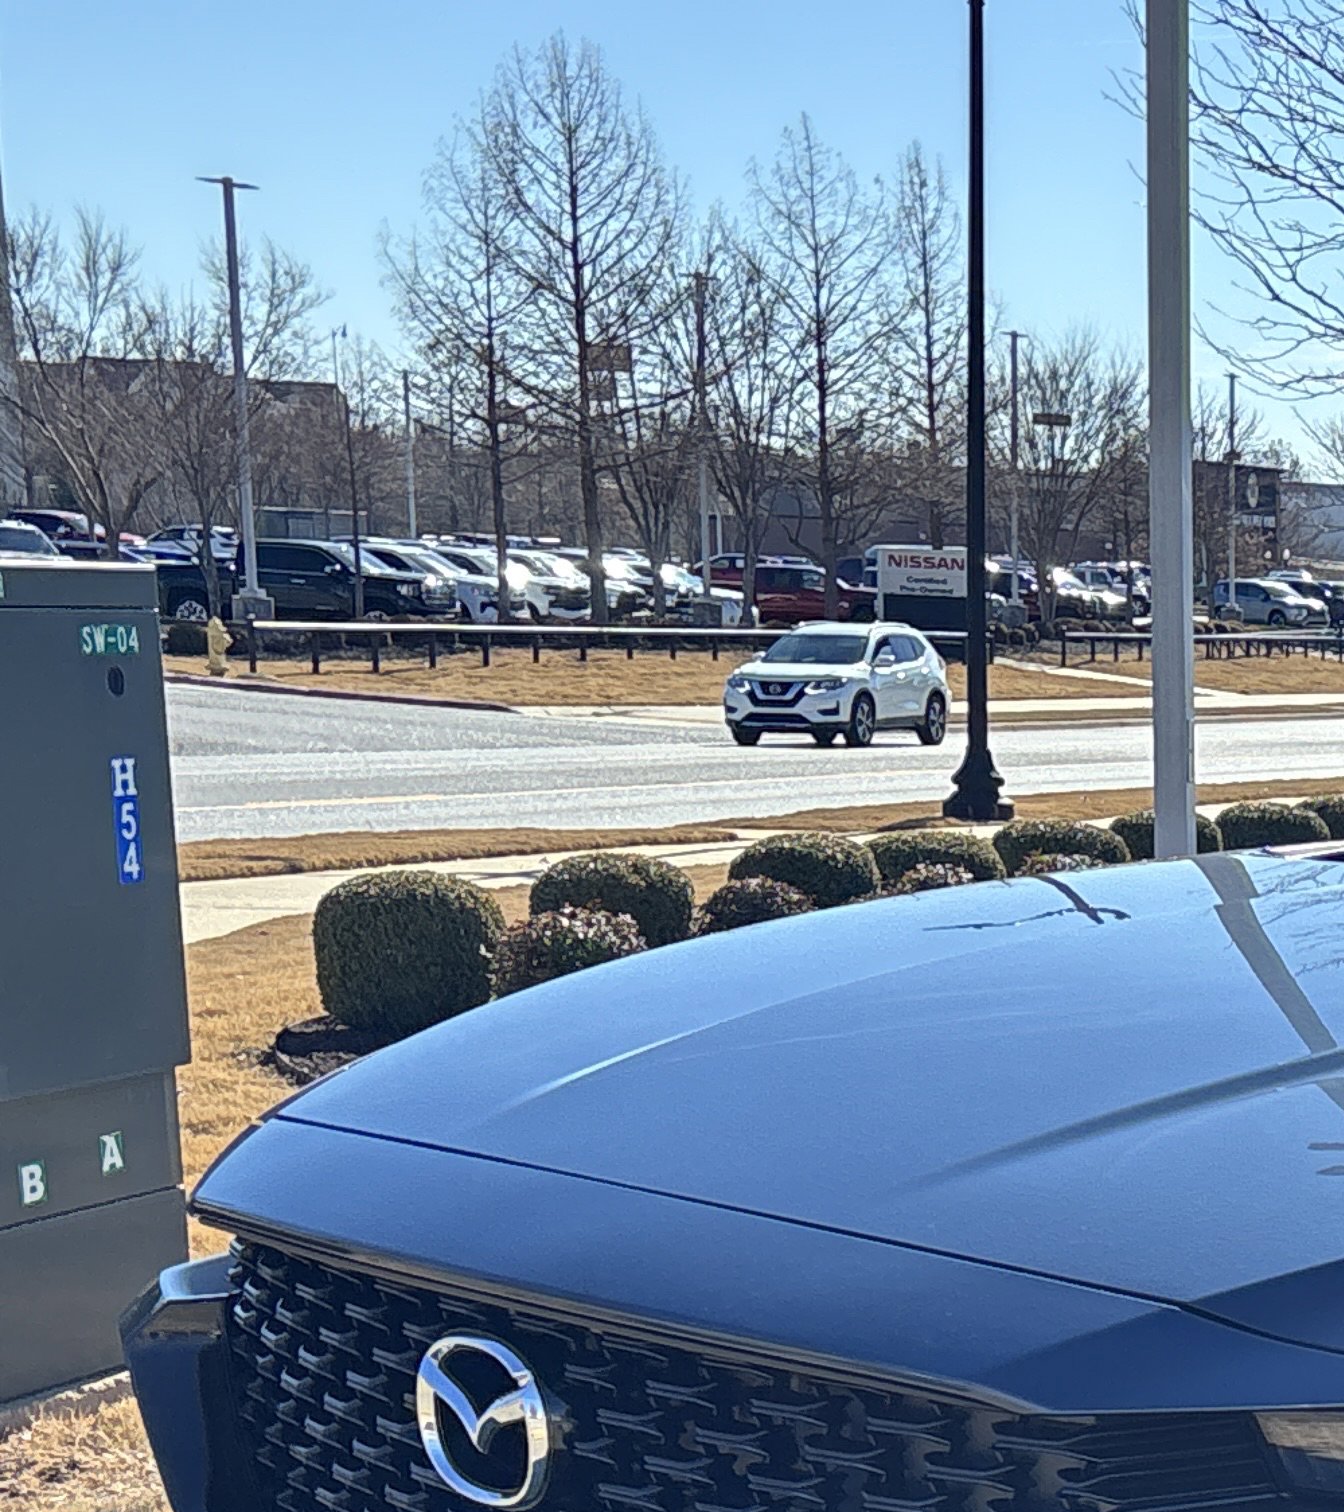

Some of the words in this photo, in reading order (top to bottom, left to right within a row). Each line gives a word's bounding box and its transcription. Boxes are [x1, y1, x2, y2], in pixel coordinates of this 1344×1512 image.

[888, 554, 964, 571] NISSAN
[82, 625, 140, 654] SW-04
[101, 1134, 124, 1173] A
[21, 1164, 45, 1204] B
